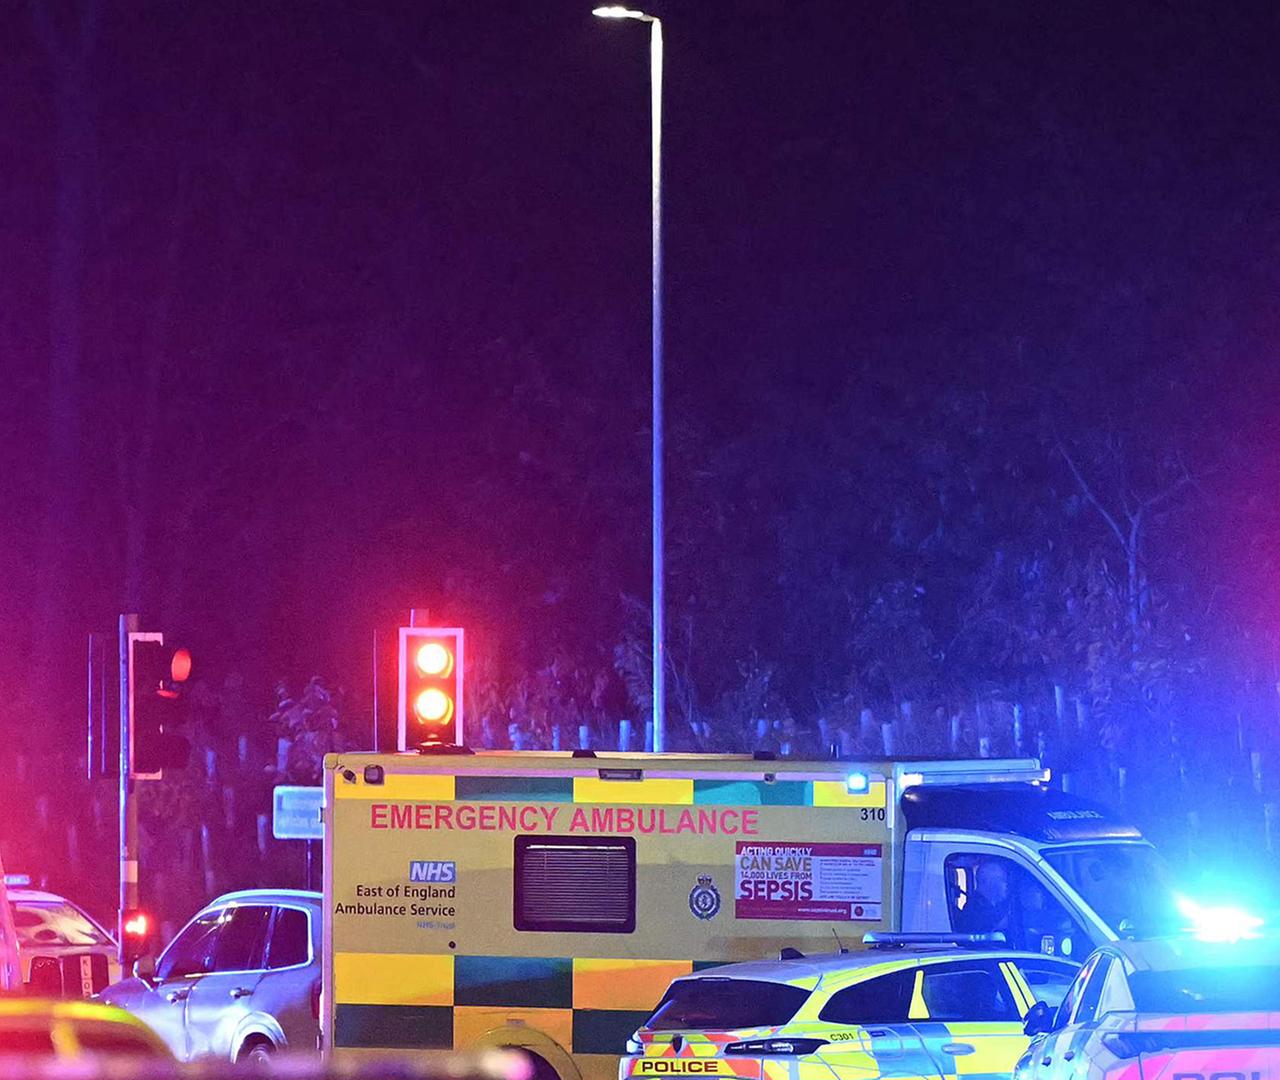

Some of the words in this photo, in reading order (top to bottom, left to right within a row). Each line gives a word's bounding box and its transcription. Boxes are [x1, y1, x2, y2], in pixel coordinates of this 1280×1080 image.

[370, 803, 560, 833] EMERGENCY
[568, 806, 760, 836] AMBULANCE
[860, 807, 886, 822] 310
[741, 845, 773, 857] ACTING
[774, 846, 813, 858] QUICKLY
[410, 861, 455, 881] NHS
[740, 856, 772, 871] CAN
[774, 856, 813, 872] SAVE
[766, 871, 789, 880] LIVES
[790, 871, 813, 881] FROM
[356, 884, 383, 897] East
[386, 884, 400, 898] of
[404, 885, 456, 901] England
[740, 879, 813, 901] SEPSIS
[334, 902, 407, 916] Ambulance
[410, 903, 456, 917] Service
[829, 1032, 855, 1042] C301
[641, 1060, 719, 1073] POLICE
